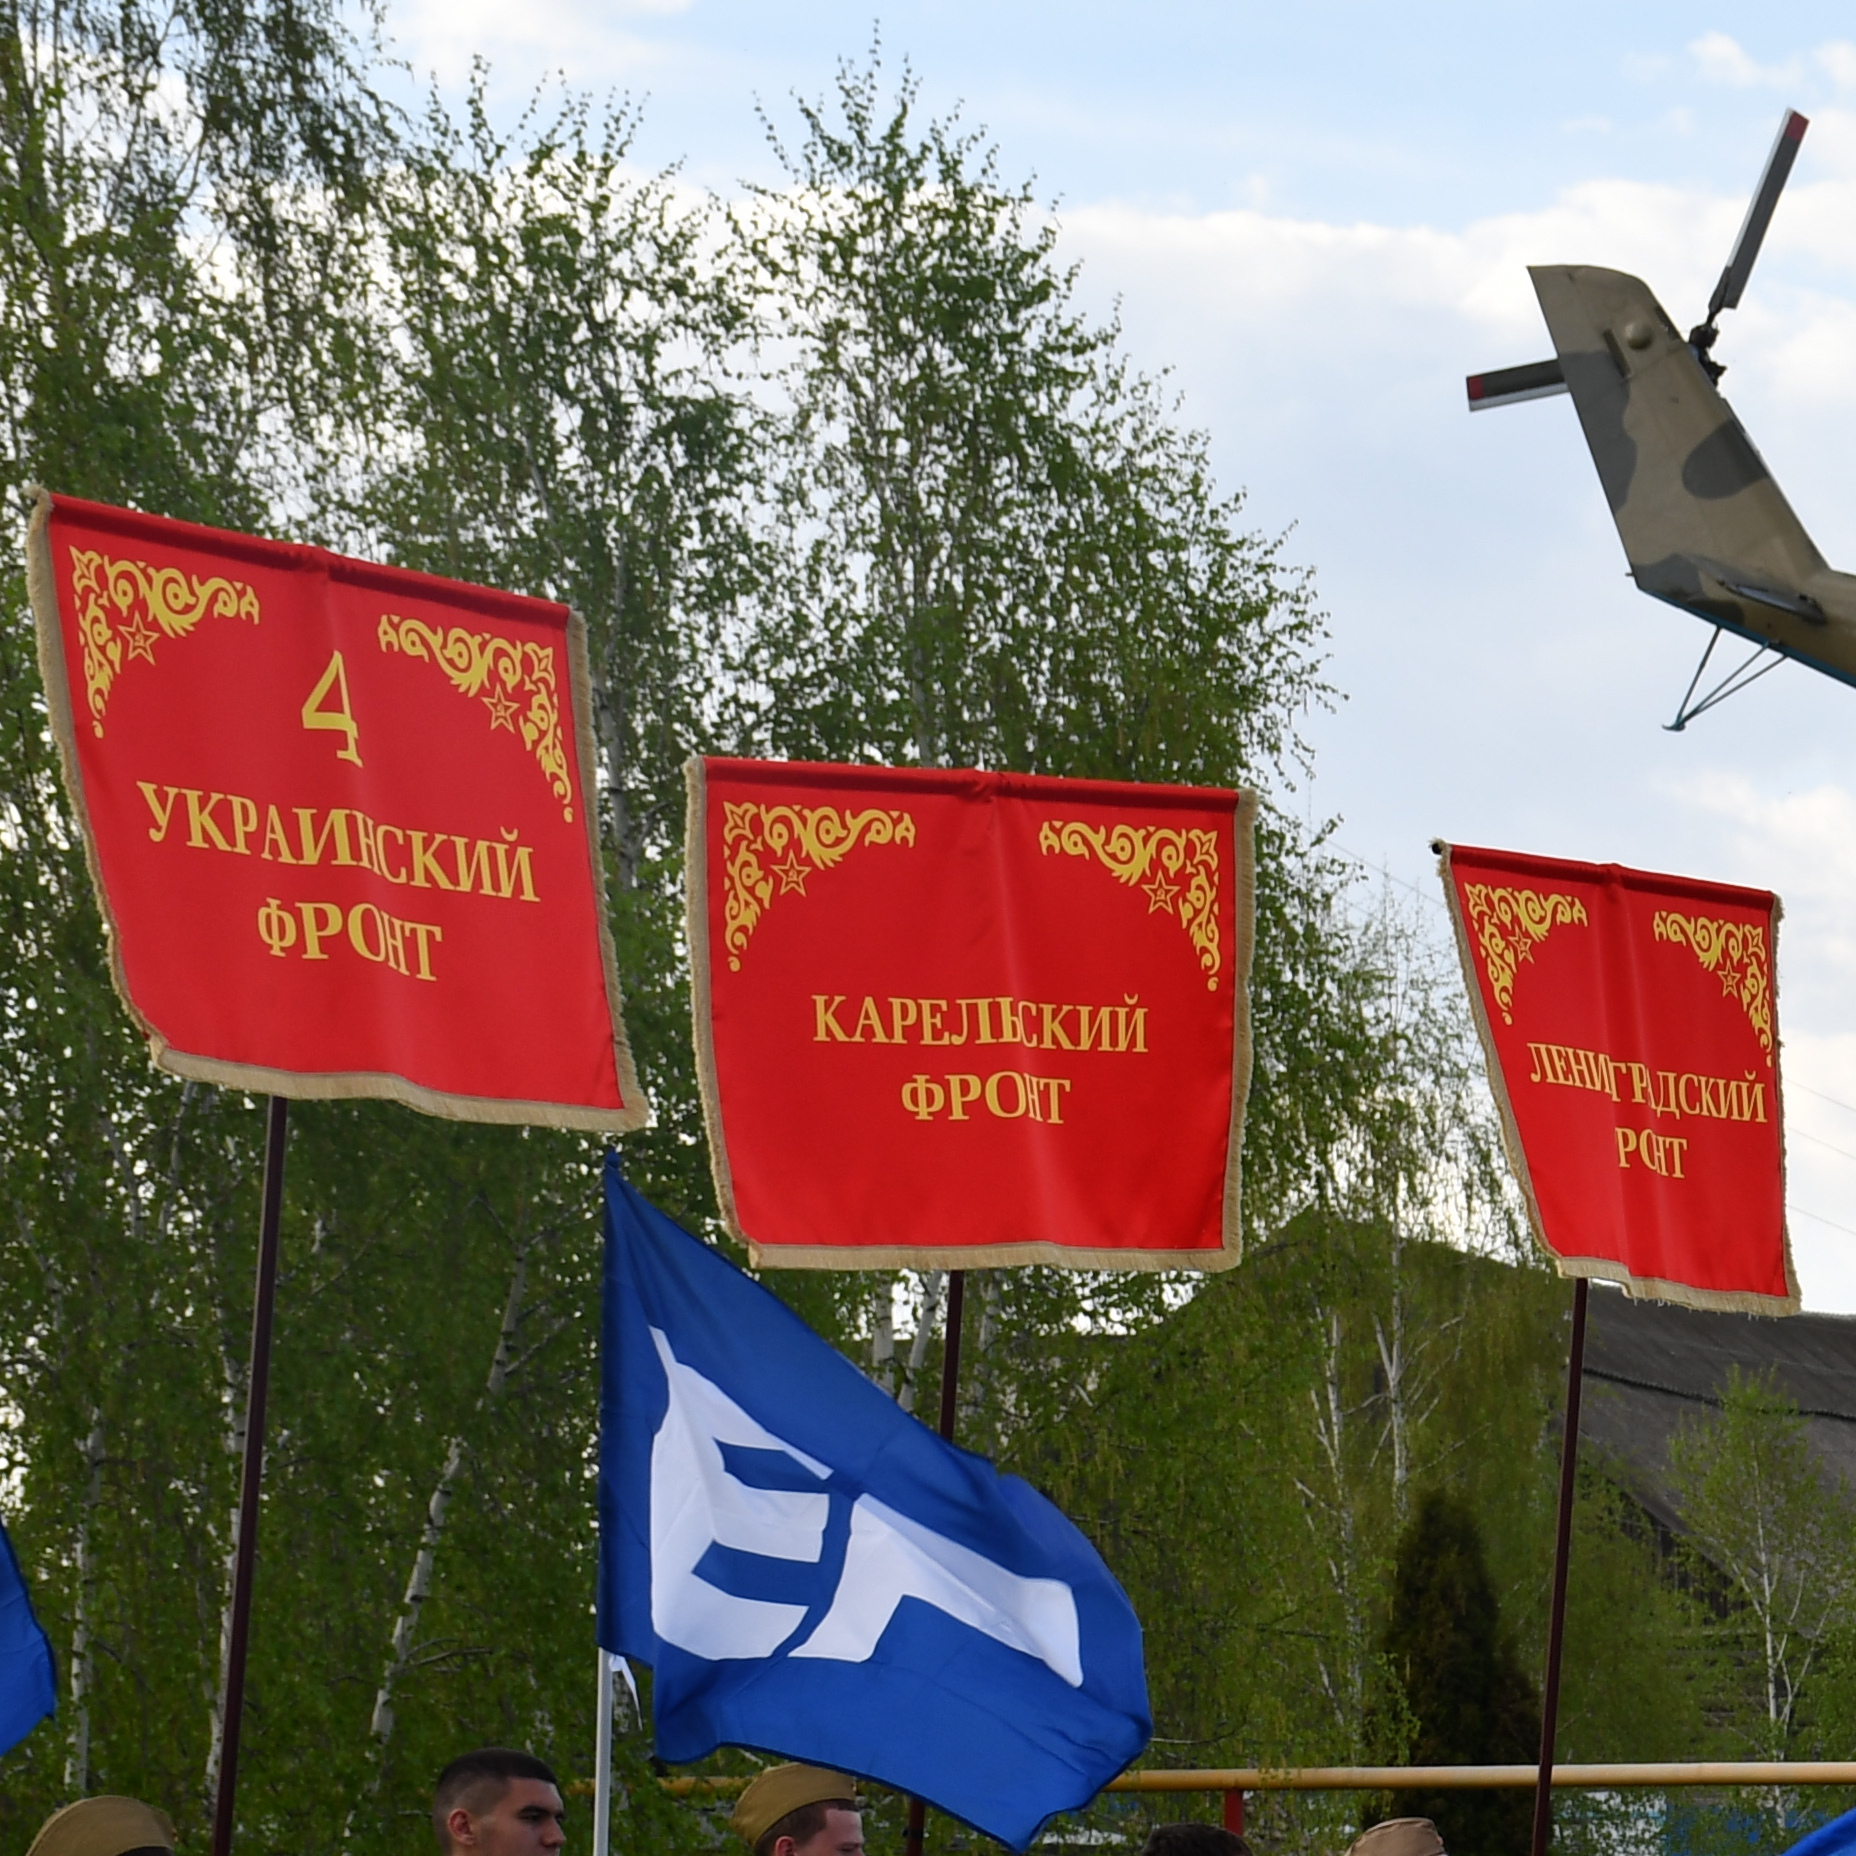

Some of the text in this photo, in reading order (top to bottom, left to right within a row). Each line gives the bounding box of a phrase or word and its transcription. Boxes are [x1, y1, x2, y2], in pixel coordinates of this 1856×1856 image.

[302, 650, 362, 767] 4
[137, 780, 541, 902] УКРАИНСКИЙ
[257, 897, 442, 981] ФРОНТ
[811, 993, 1149, 1054] КАРЕЛЬСКИЙ
[901, 1070, 1071, 1124] ФРОНТ
